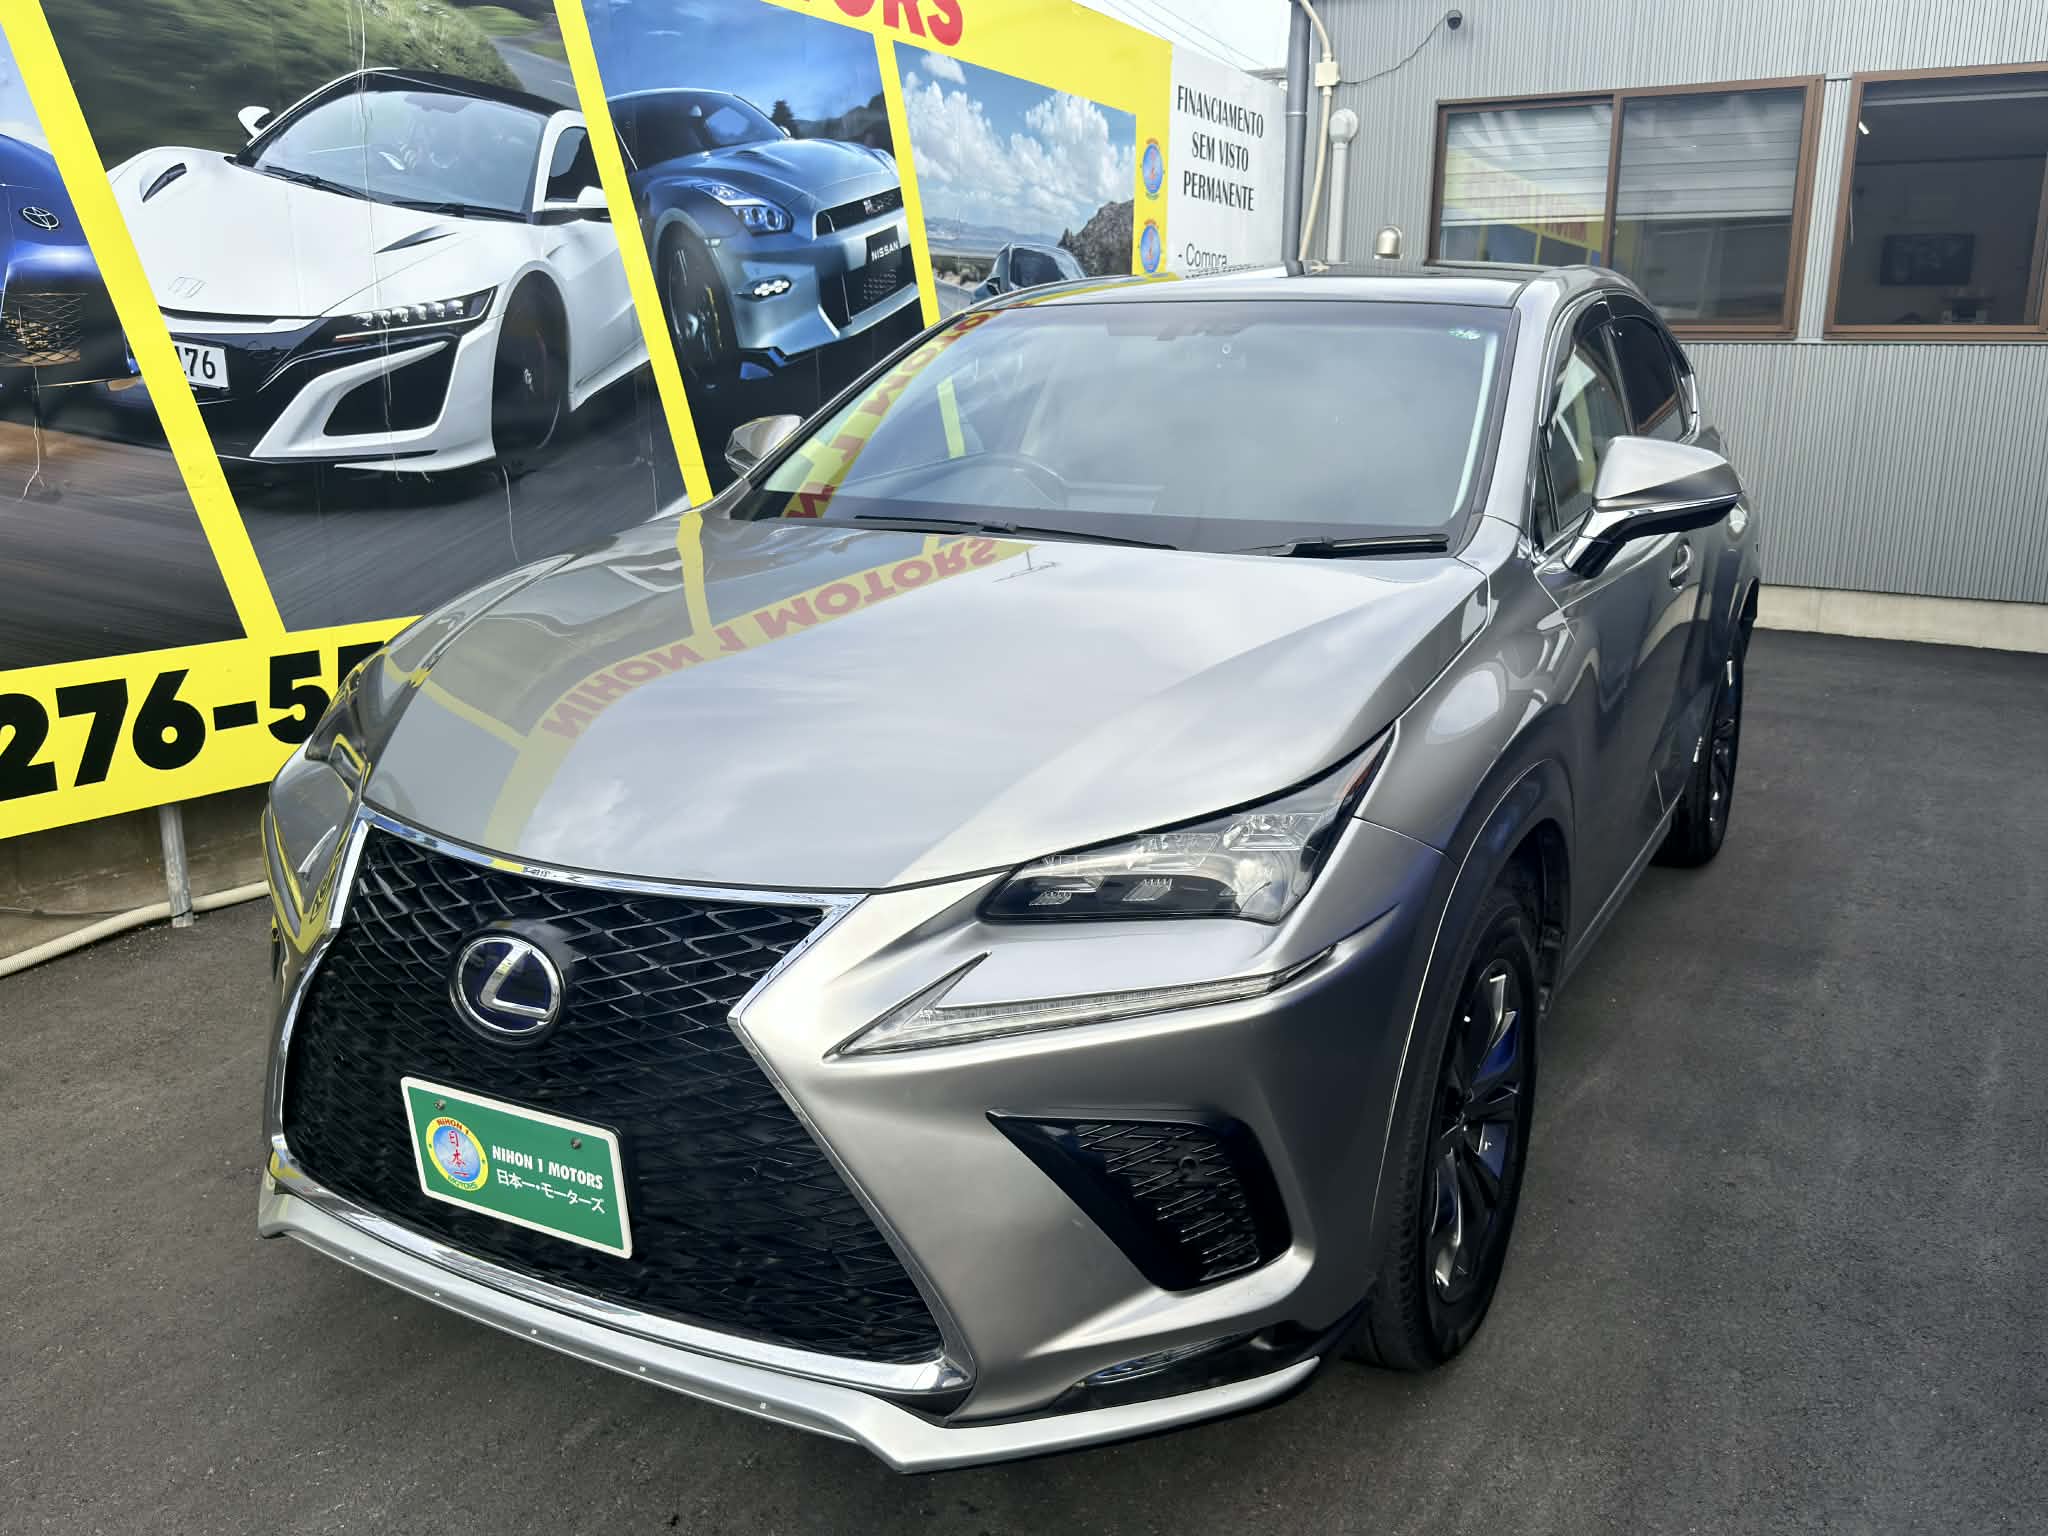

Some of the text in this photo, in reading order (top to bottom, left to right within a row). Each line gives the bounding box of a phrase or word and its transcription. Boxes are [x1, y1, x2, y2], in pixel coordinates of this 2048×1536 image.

[1177, 85, 1264, 138] FINANCIAMENTO
[1192, 131, 1249, 172] SEM VISTO
[1183, 170, 1255, 211] PERMANENTE
[871, 241, 899, 261] NISSAN
[174, 345, 216, 379] 76
[492, 1145, 603, 1190] NIHON 1 MOTORS
